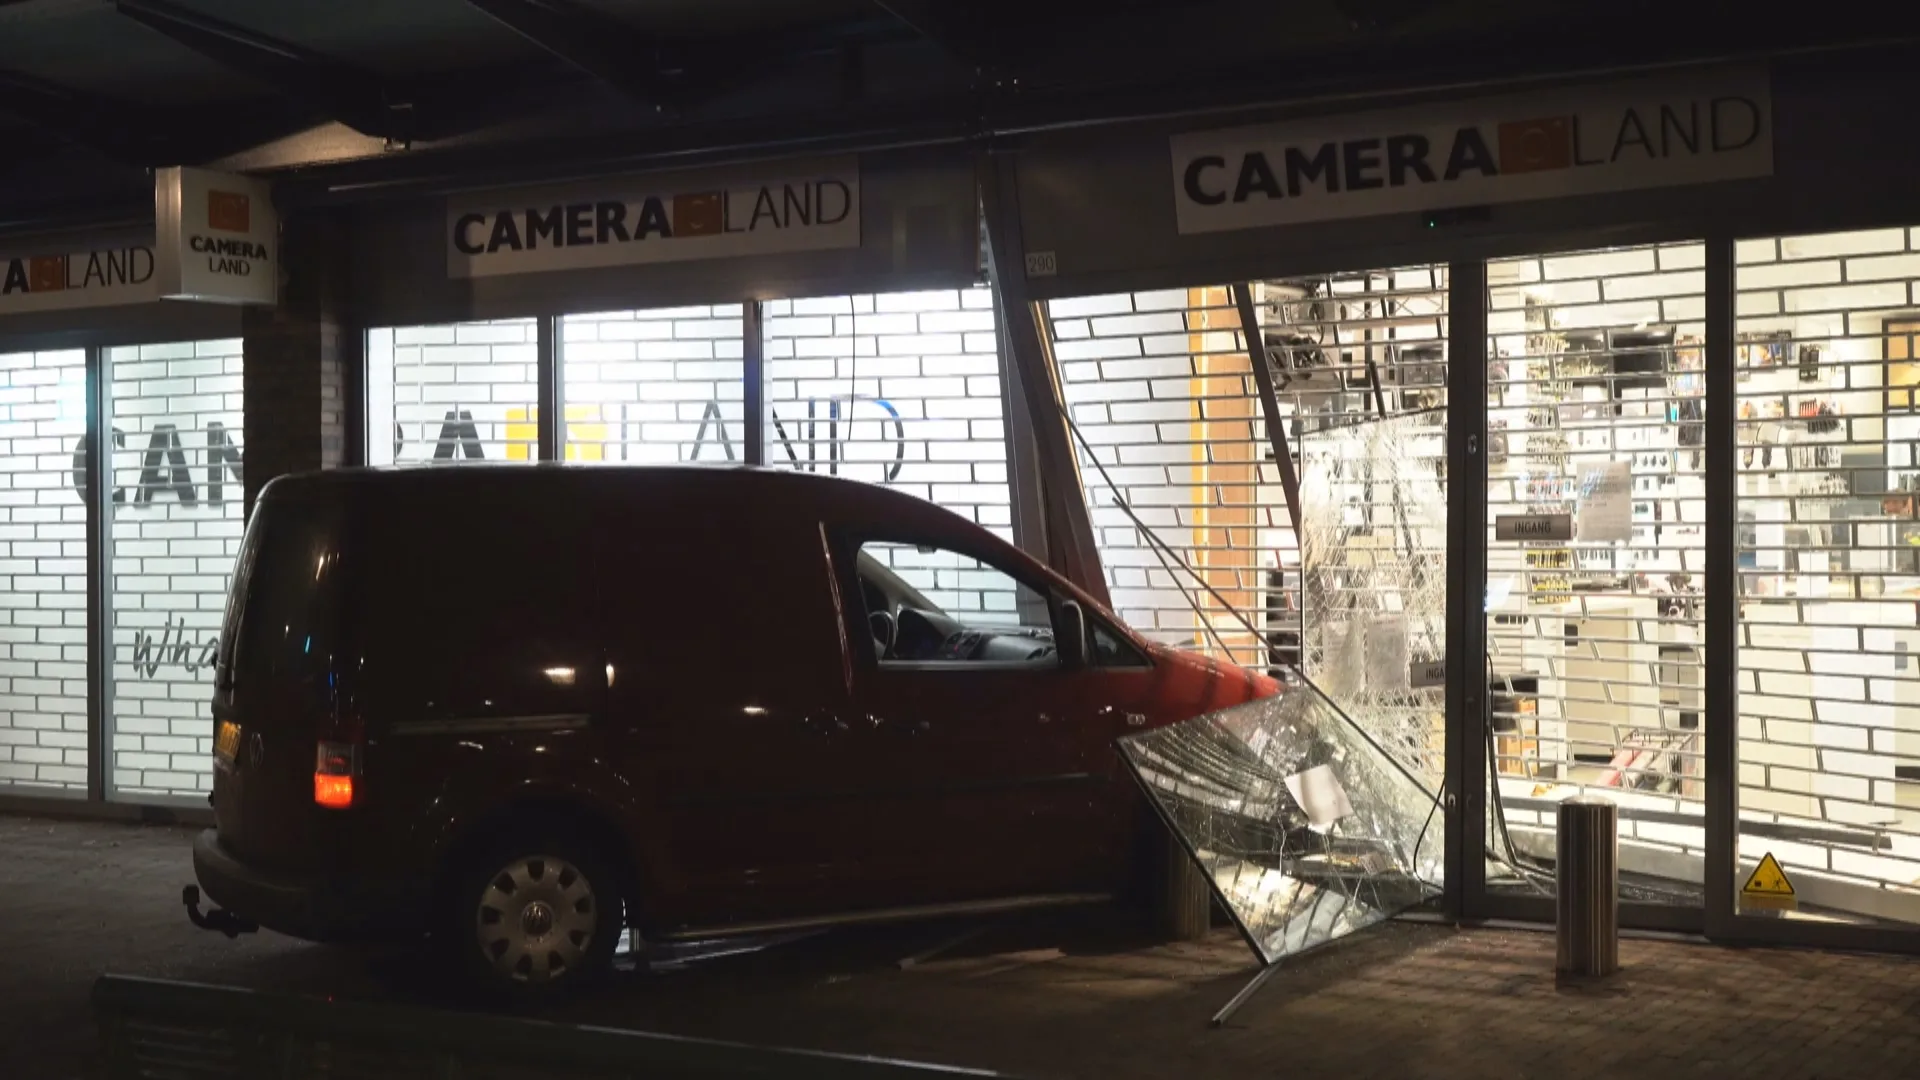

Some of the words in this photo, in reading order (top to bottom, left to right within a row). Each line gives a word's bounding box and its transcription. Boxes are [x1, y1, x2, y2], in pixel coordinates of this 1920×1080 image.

[1183, 126, 1499, 206] CAMERA
[1573, 96, 1761, 167] LAND
[454, 196, 673, 255] CAMERA
[723, 180, 852, 233] LAND
[190, 235, 268, 261] CAMERA
[66, 247, 155, 290] LAND
[209, 256, 250, 276] LAND
[1029, 255, 1054, 272] 290
[1514, 521, 1551, 534] INGANG
